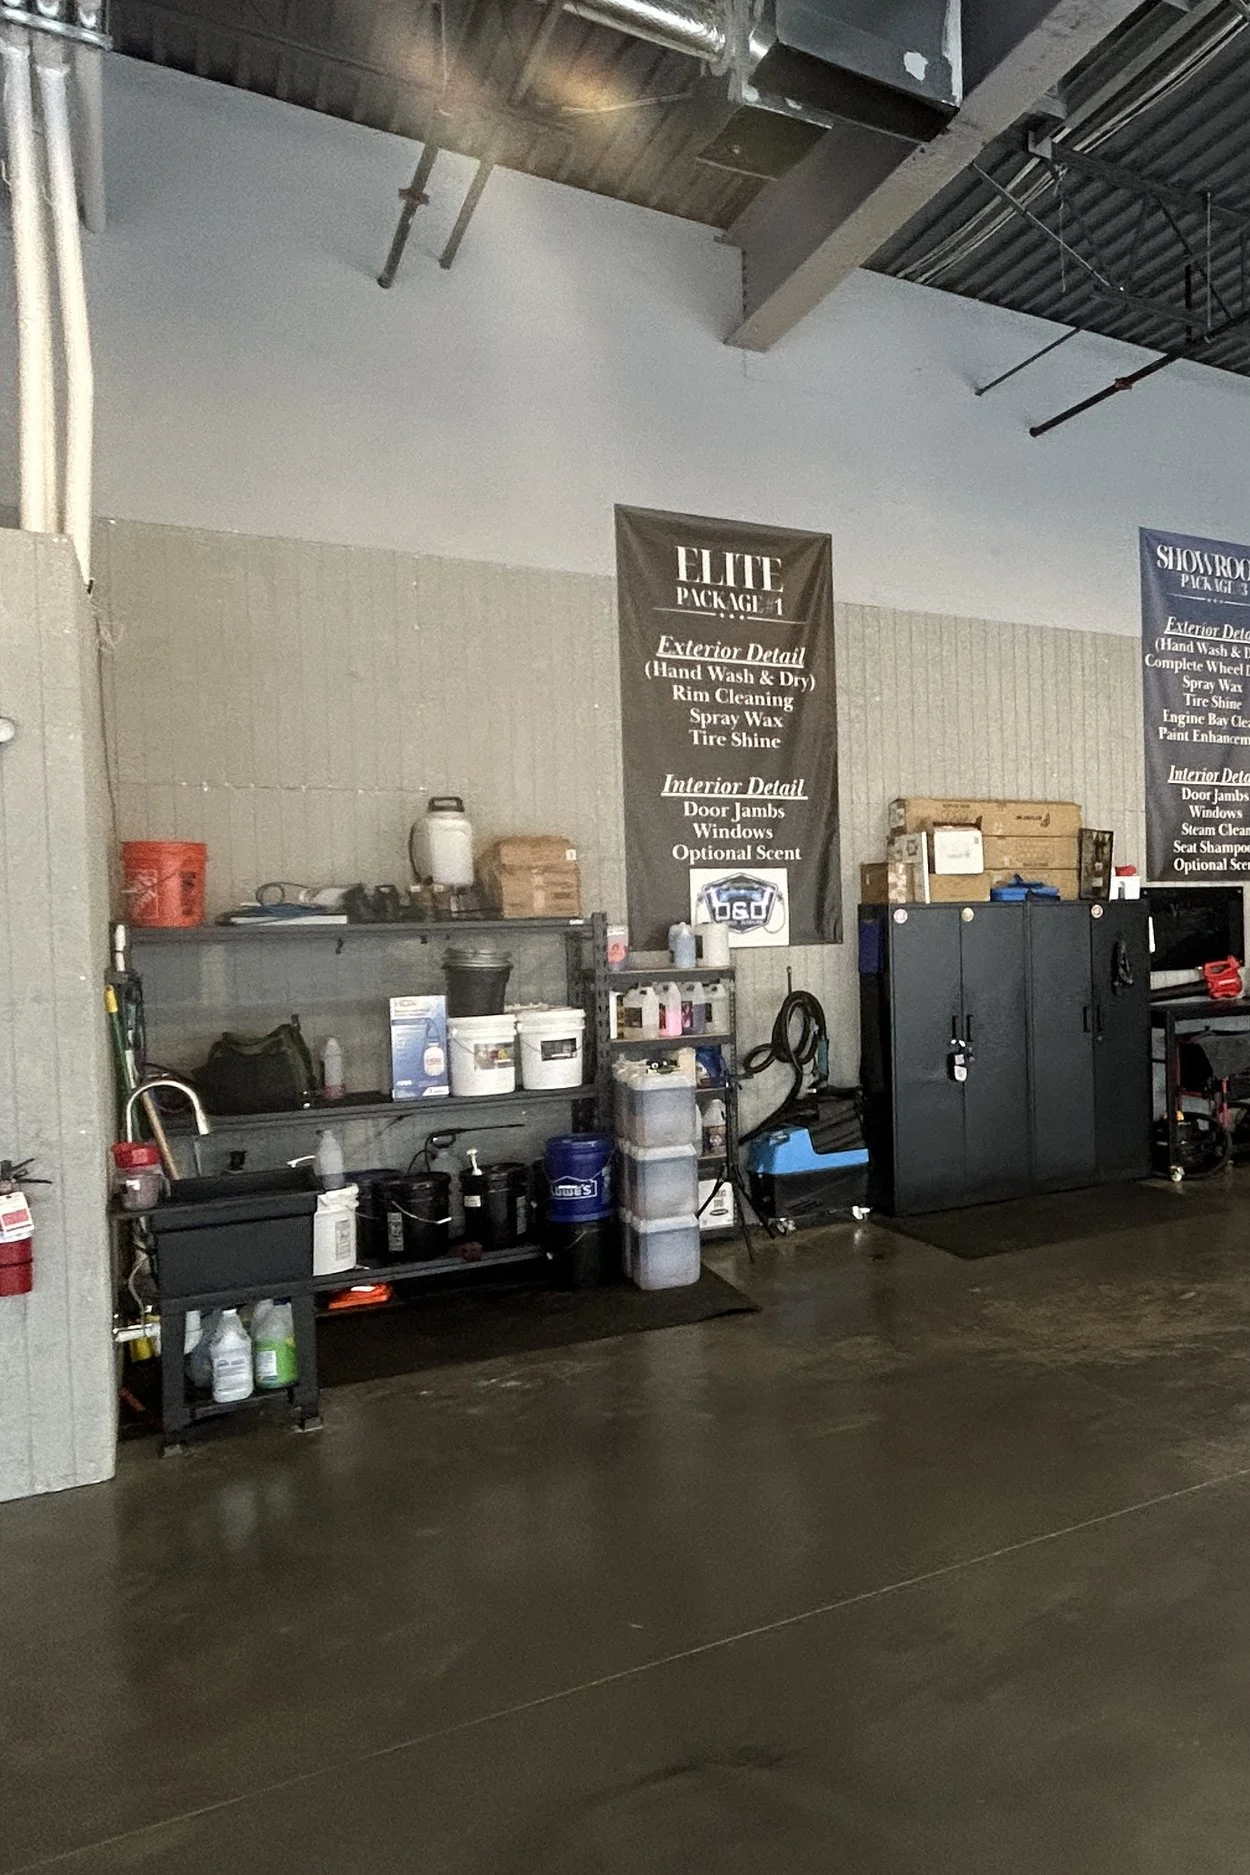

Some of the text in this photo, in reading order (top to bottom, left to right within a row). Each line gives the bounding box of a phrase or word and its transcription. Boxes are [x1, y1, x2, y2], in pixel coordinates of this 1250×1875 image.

[675, 546, 784, 593] ELITE
[1181, 573, 1235, 594] PACKAGE
[676, 586, 764, 614] PACKAGE
[1165, 616, 1220, 638] Exterior
[658, 635, 806, 665] Exterior Detail
[1155, 637, 1194, 653] (Hand
[1196, 641, 1228, 657] Wash
[1230, 645, 1241, 659] &
[1145, 653, 1203, 674] Complete
[1206, 660, 1244, 676] Wheel
[645, 661, 816, 692] (Hand Wash & Dry)
[1182, 674, 1243, 694] Spray Wax
[672, 684, 794, 712] Rim Cleaning
[1183, 692, 1242, 711] Tire Shine
[690, 708, 784, 730] Spray Wax
[1163, 708, 1205, 728] Engine
[1207, 712, 1228, 730] Bay
[689, 729, 782, 749] Tire Shine
[1158, 726, 1190, 742] Paint
[1169, 764, 1220, 783] Interior
[662, 774, 805, 796] Interior Detail
[1181, 787, 1250, 805] Door Jambs
[683, 801, 785, 823] Door Jambs
[1189, 805, 1243, 819] Windows
[693, 822, 774, 840] Windows
[1181, 822, 1216, 837] Steam
[672, 844, 802, 865] Optional Scent
[1173, 840, 1198, 854] Seat
[1173, 857, 1227, 875] Optional
